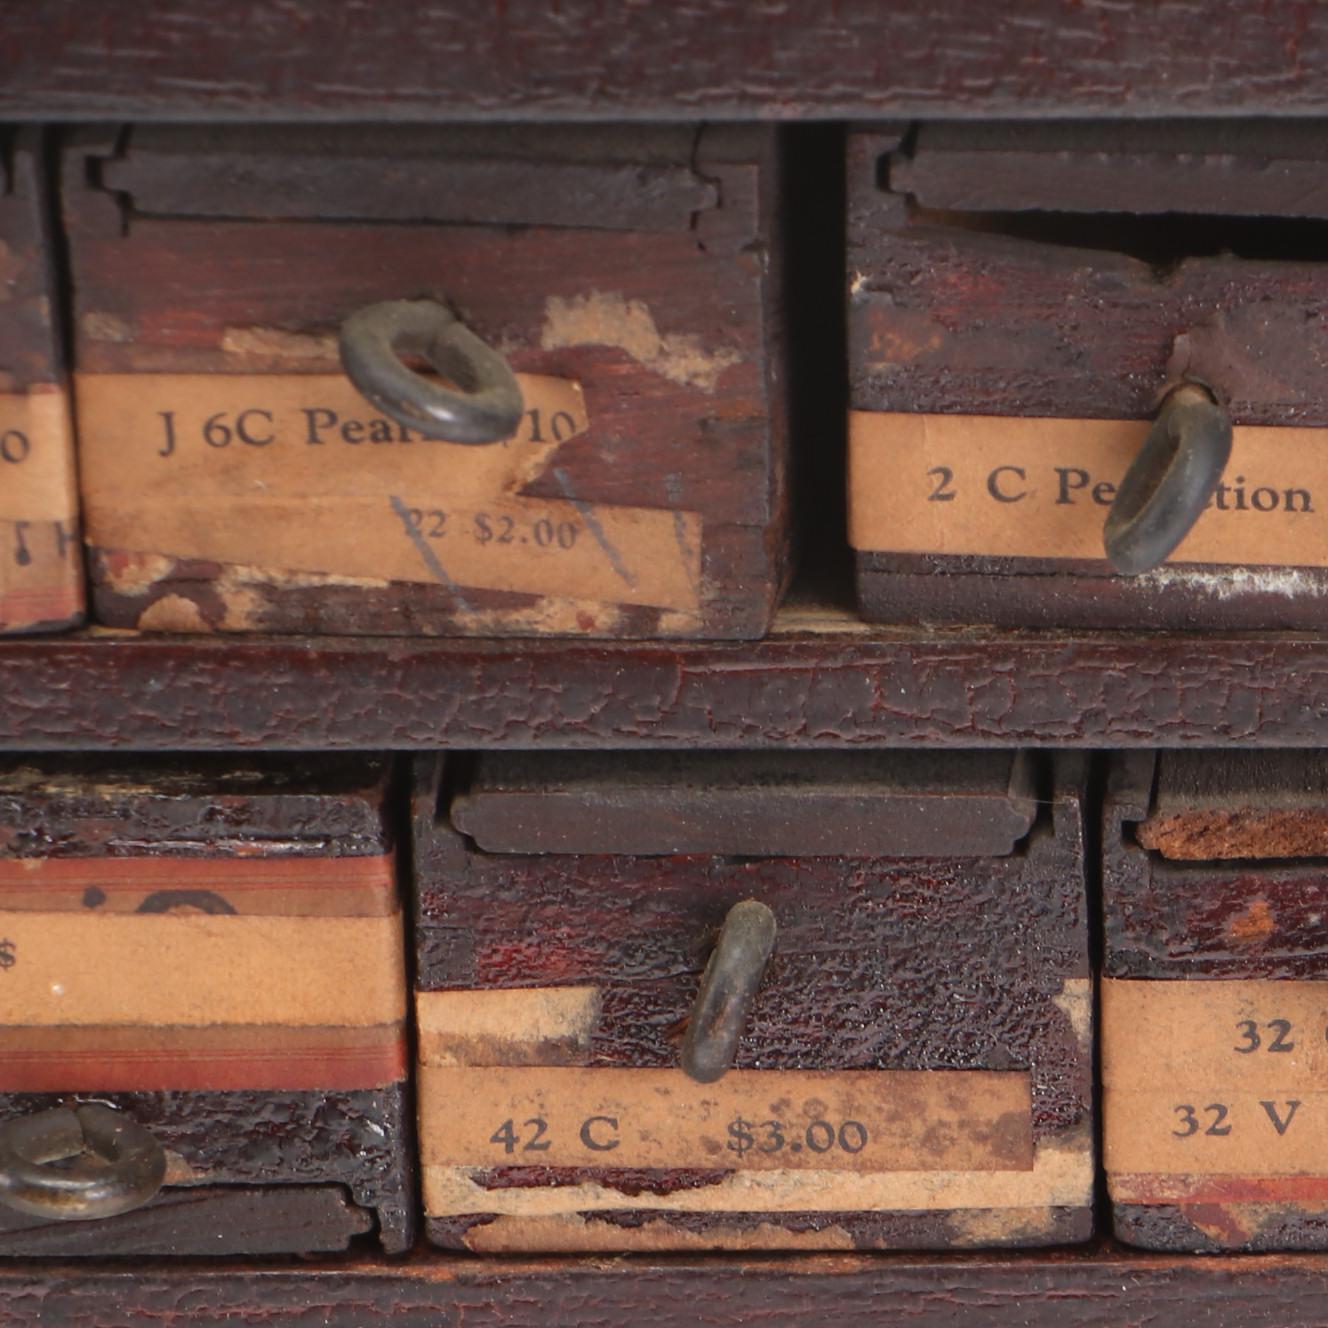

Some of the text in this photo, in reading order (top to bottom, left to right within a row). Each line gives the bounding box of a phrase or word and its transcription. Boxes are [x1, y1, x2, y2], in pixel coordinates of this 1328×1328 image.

[158, 411, 176, 459] J
[303, 408, 432, 444] Pear
[927, 466, 957, 502] 2
[986, 465, 1028, 504] C
[1054, 465, 1316, 515] Petion
[474, 509, 579, 550] $2.00
[1233, 1018, 1295, 1055] 32
[489, 1114, 871, 1157] 42 C $3.00
[1171, 1102, 1233, 1139] 32
[1258, 1099, 1302, 1137] V
